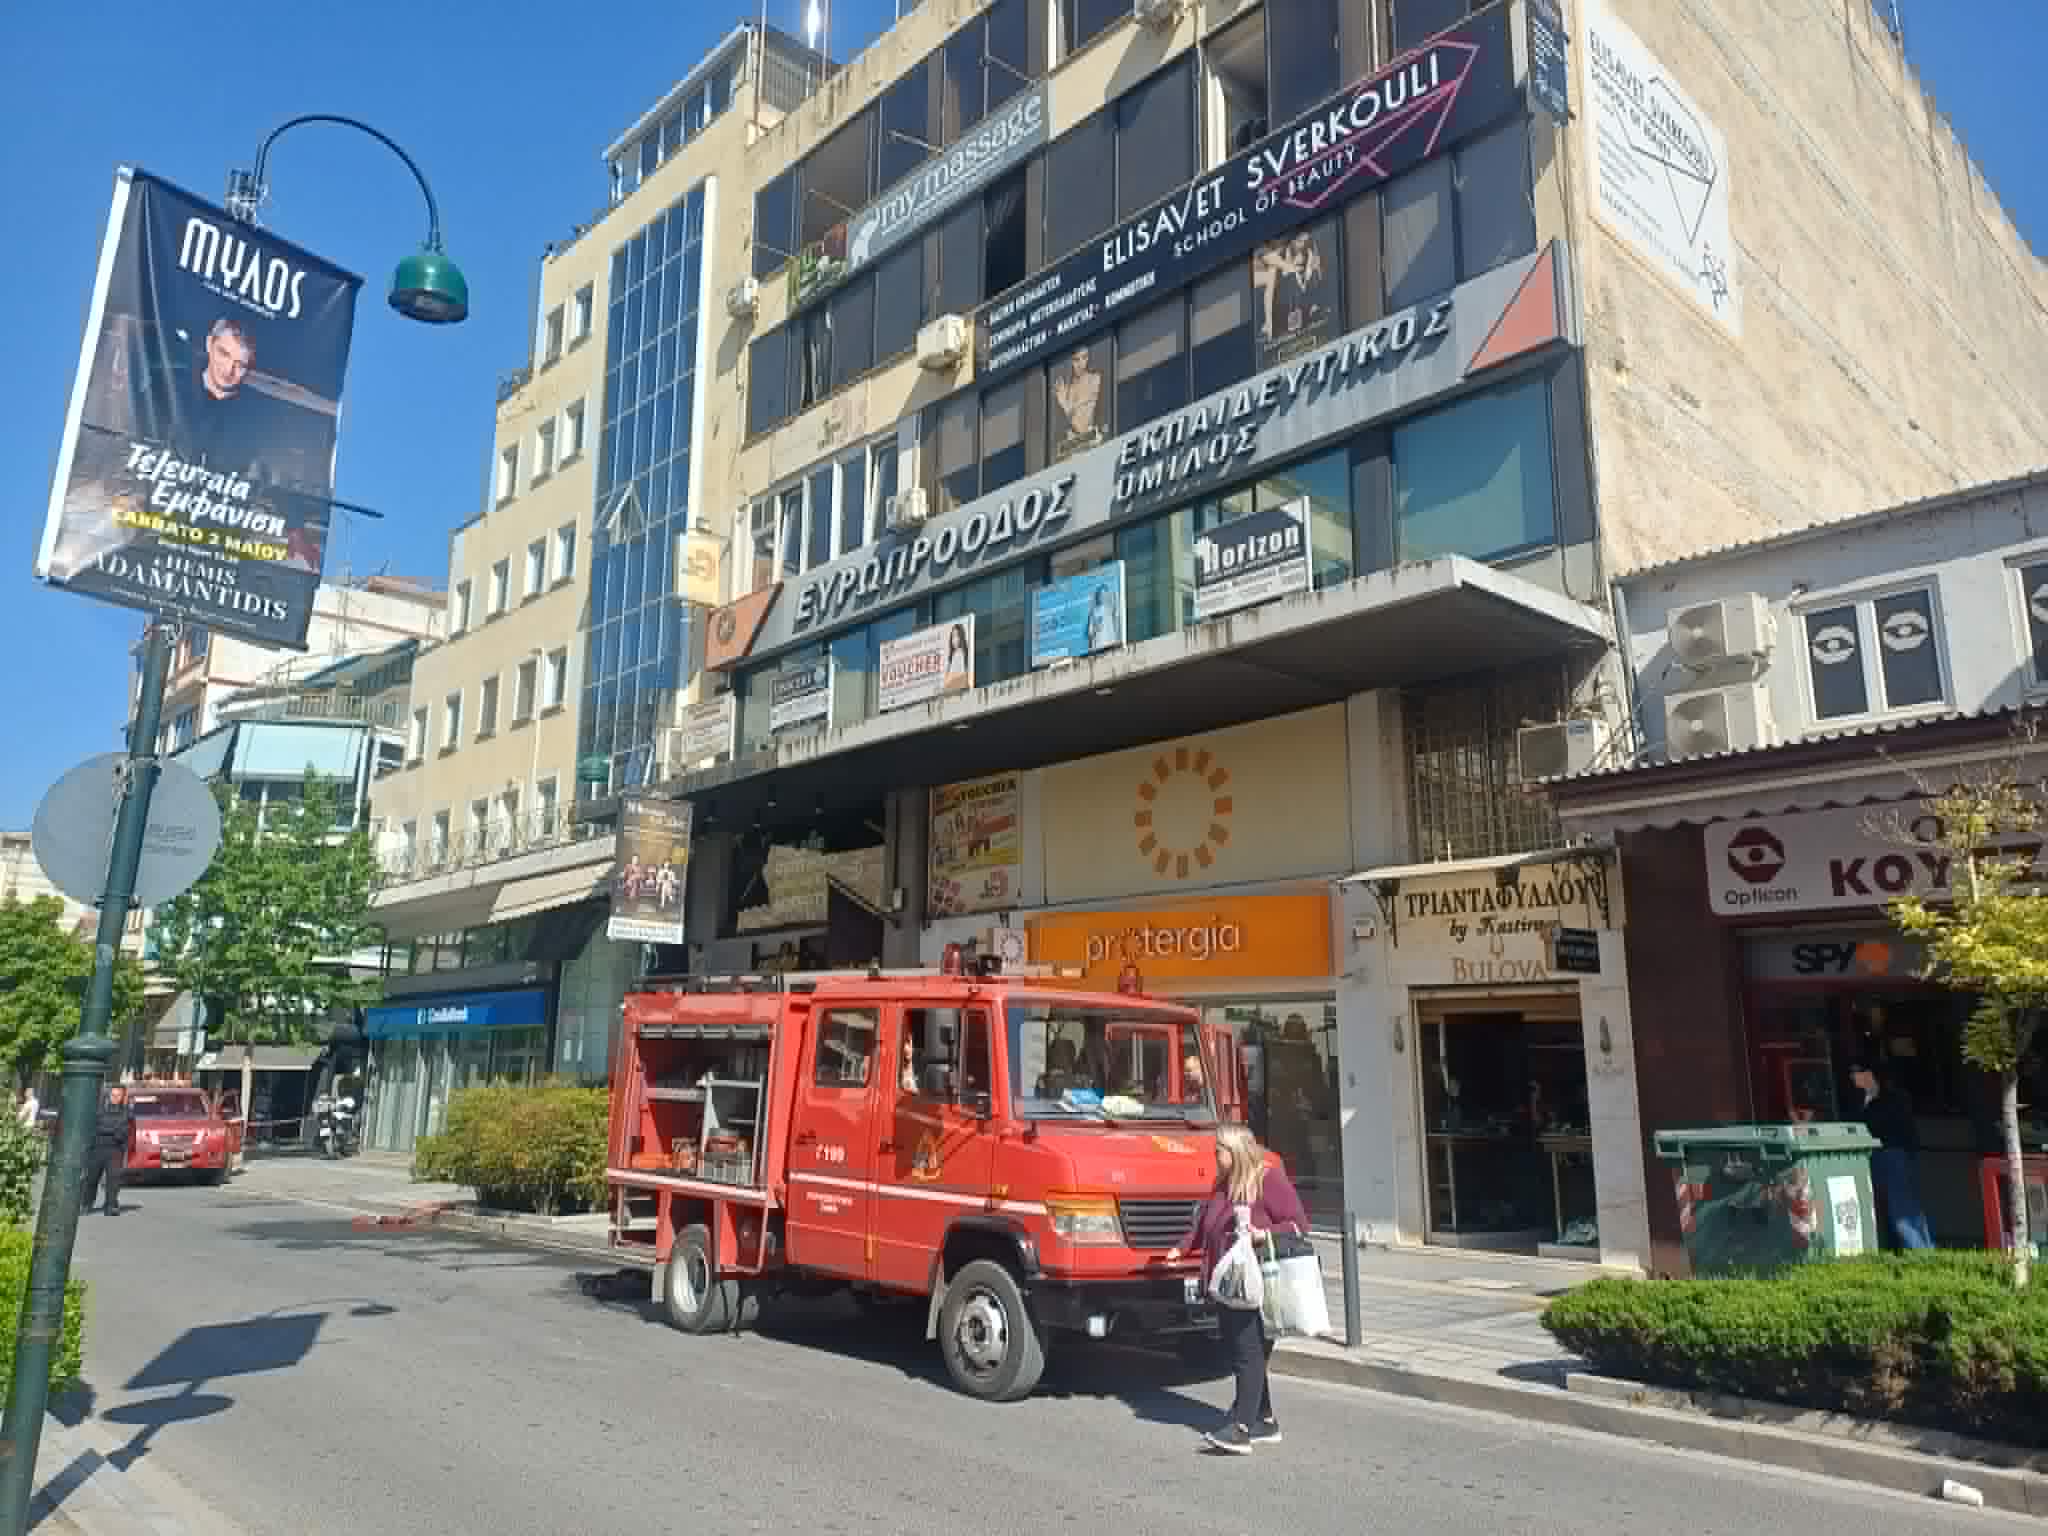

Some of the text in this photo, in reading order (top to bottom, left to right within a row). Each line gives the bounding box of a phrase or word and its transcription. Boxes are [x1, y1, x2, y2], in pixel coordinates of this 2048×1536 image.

[922, 95, 1043, 199] massage
[1103, 175, 1225, 273] ELISAVET
[1247, 51, 1440, 189] SVERKOULI
[1173, 142, 1355, 258] SCHOOL OF BEAUTY
[127, 442, 251, 501] Τελευταία
[797, 472, 1078, 622] ΕΥΡΩΠΡΟΟΔΟΣ
[1120, 298, 1456, 466] ΕΚΠΑΙΔΕΥΤΙΚΟΣ
[1117, 421, 1257, 502] ΟΜΙΛΟΣ
[151, 479, 287, 537] Εμφάνιση
[208, 531, 220, 545] 2
[94, 551, 288, 621] ADAMANTIDIS
[1405, 878, 1594, 918] ΤΡΙΑΝΤΑΦΥΛΛΟΥ
[1084, 913, 1241, 970] protergia
[1449, 918, 1468, 943] by
[1451, 958, 1547, 983] BULOVA
